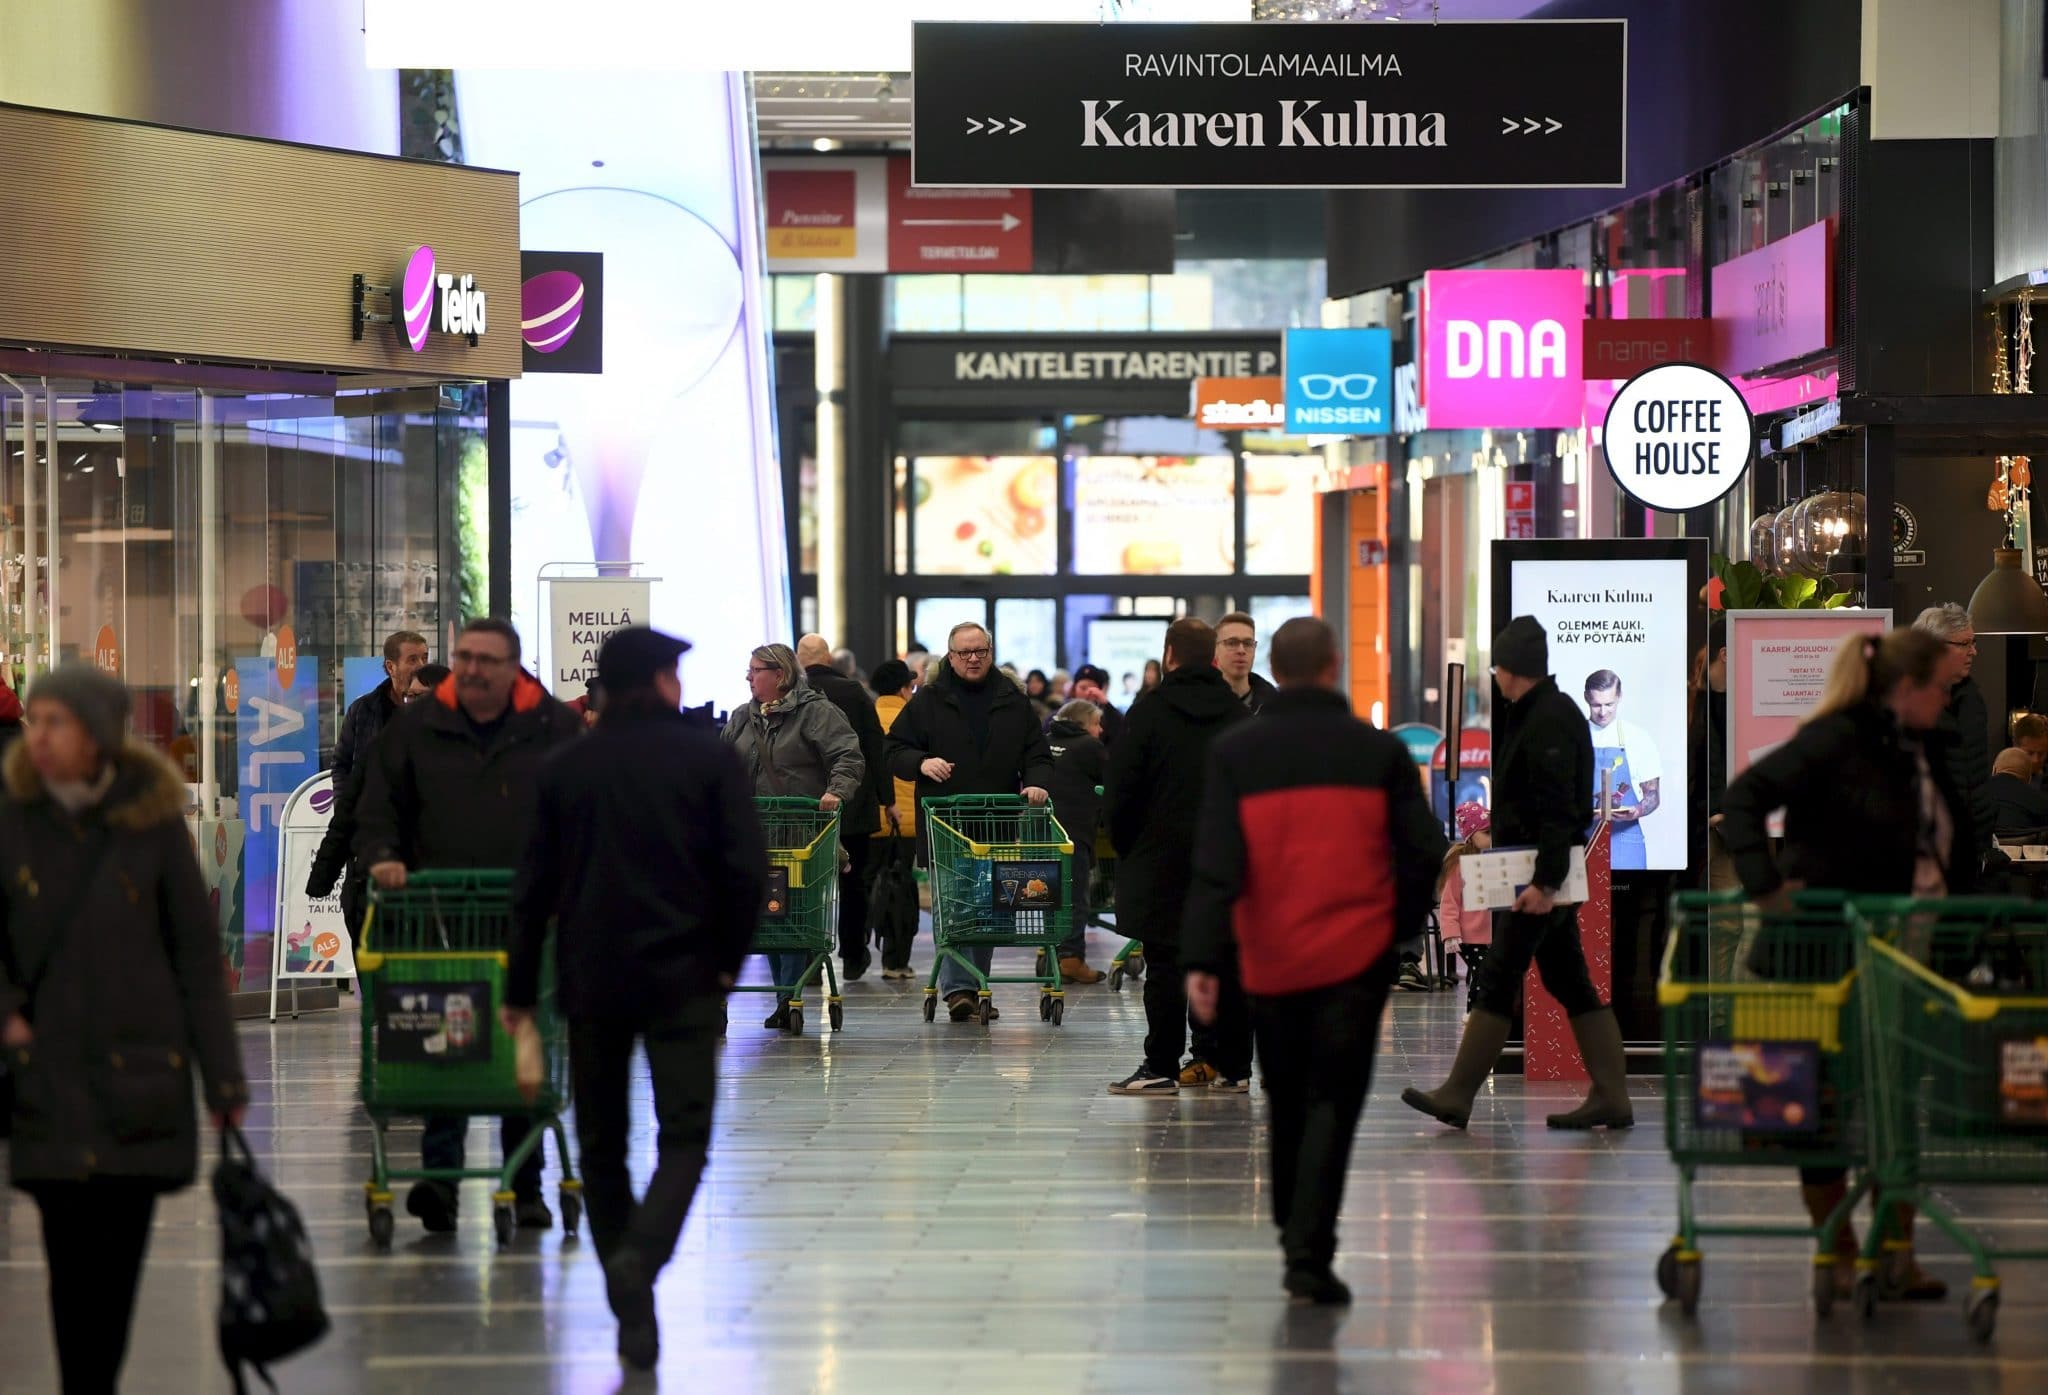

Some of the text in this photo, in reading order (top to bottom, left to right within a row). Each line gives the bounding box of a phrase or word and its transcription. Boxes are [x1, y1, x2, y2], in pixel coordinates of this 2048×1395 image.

[1125, 53, 1402, 77] RAVINTOLAMAAILMA
[1081, 100, 1448, 147] Kaaren Kulma
[437, 273, 486, 335] Telia
[1446, 319, 1567, 379] DNA
[1598, 339, 1668, 362] name
[955, 352, 1251, 380] KANTELETTARENTIE
[1202, 399, 1285, 425] stadiu
[1295, 406, 1382, 424] NISSEN
[1634, 400, 1721, 433] COFFEE
[1635, 442, 1720, 475] HOUSE
[1547, 589, 1653, 603] Kaaren Kulma
[568, 608, 632, 626] MEILLÄ
[1557, 620, 1645, 631] OLEMME AUKI.
[1556, 631, 1646, 643] KÄY PÖYTÄÄN!
[99, 654, 116, 672] ALE
[277, 652, 294, 669] ALE
[560, 668, 600, 682] LAIT
[226, 684, 239, 700] ALE
[248, 697, 305, 833] ALE
[308, 904, 342, 914] TAI KU
[316, 937, 339, 955] ALE
